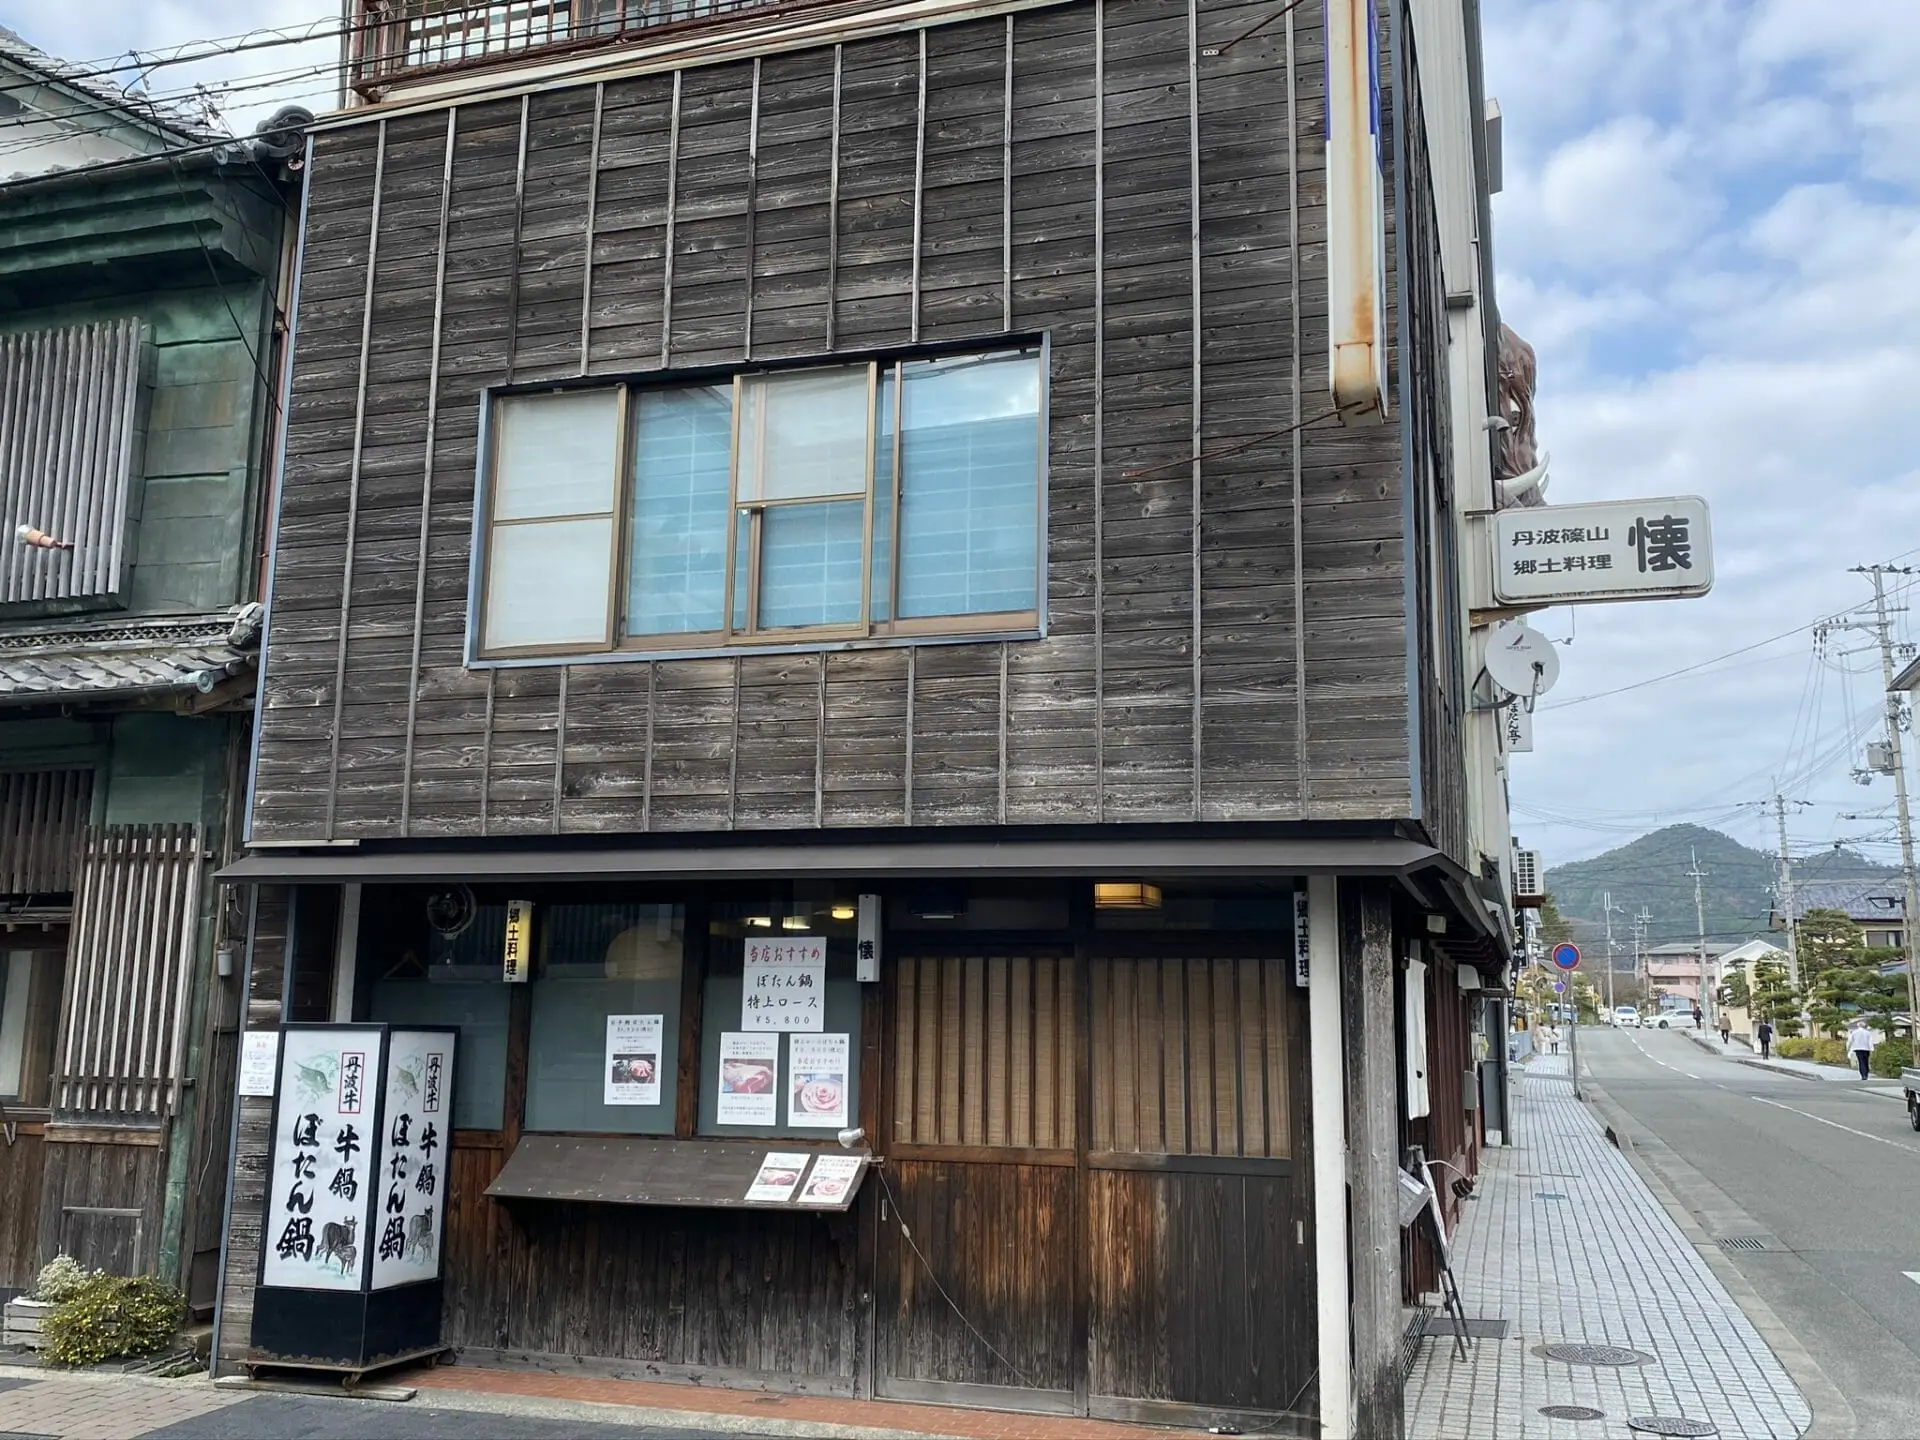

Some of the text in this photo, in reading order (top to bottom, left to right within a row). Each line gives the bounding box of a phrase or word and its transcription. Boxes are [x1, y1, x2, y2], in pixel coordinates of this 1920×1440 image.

[1511, 525, 1610, 547] 丹波篠山
[1628, 514, 1693, 573] 懐
[1513, 553, 1613, 576] 郷土料理
[750, 944, 821, 963] 当店おすすめ
[858, 939, 874, 961] 懐
[747, 994, 818, 1009] 特上ロース
[756, 973, 814, 988] ぼたん鍋
[342, 1056, 361, 1112] 丹波牛
[426, 1055, 441, 1110] 丹波牛
[276, 1113, 324, 1263] ぼたん鍋
[329, 1124, 360, 1202] 牛鍋
[379, 1113, 412, 1263] ぼたん鍋
[415, 1122, 438, 1201] 牛鍋
